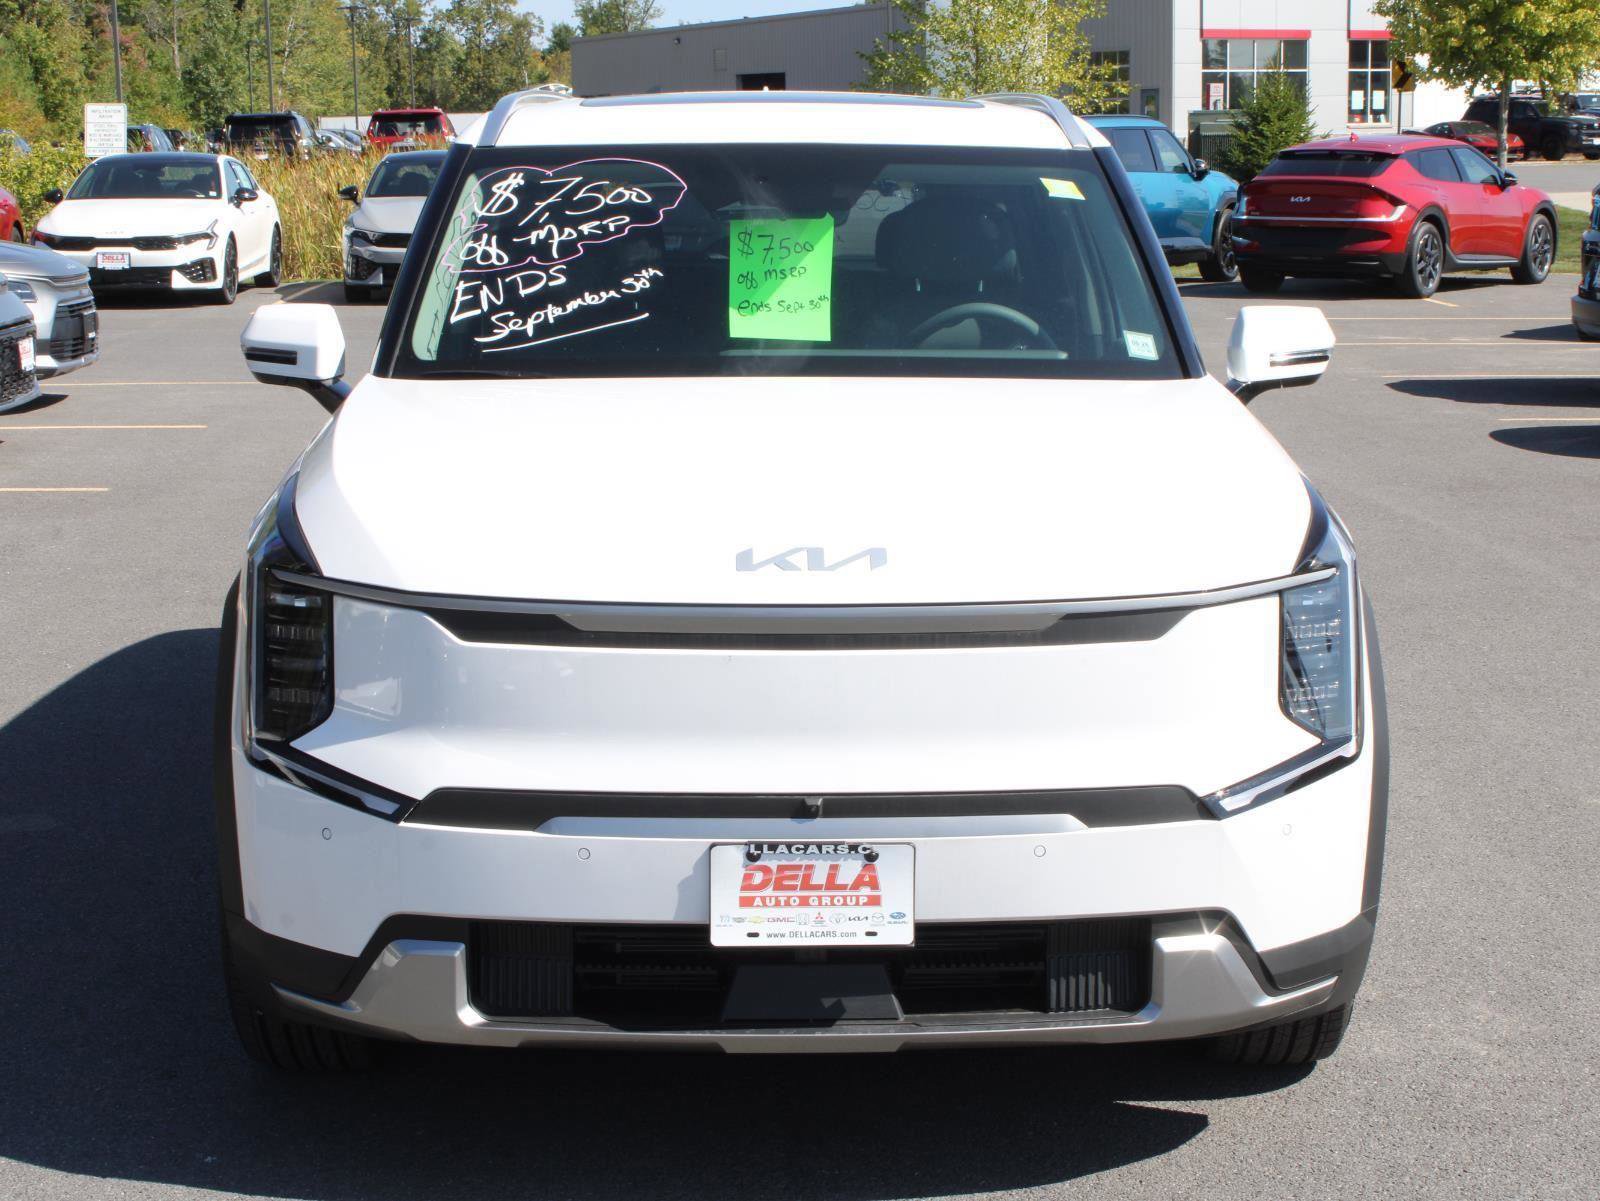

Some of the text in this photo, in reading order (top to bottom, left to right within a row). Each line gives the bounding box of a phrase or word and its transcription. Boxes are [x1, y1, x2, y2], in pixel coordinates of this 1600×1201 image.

[450, 265, 567, 324] ENDS
[474, 289, 622, 343] September
[735, 547, 888, 572] KIA
[739, 862, 882, 892] DELLA
[753, 896, 869, 907] AUTO GROUP
[766, 930, 858, 939] www.DELLACARS.com
